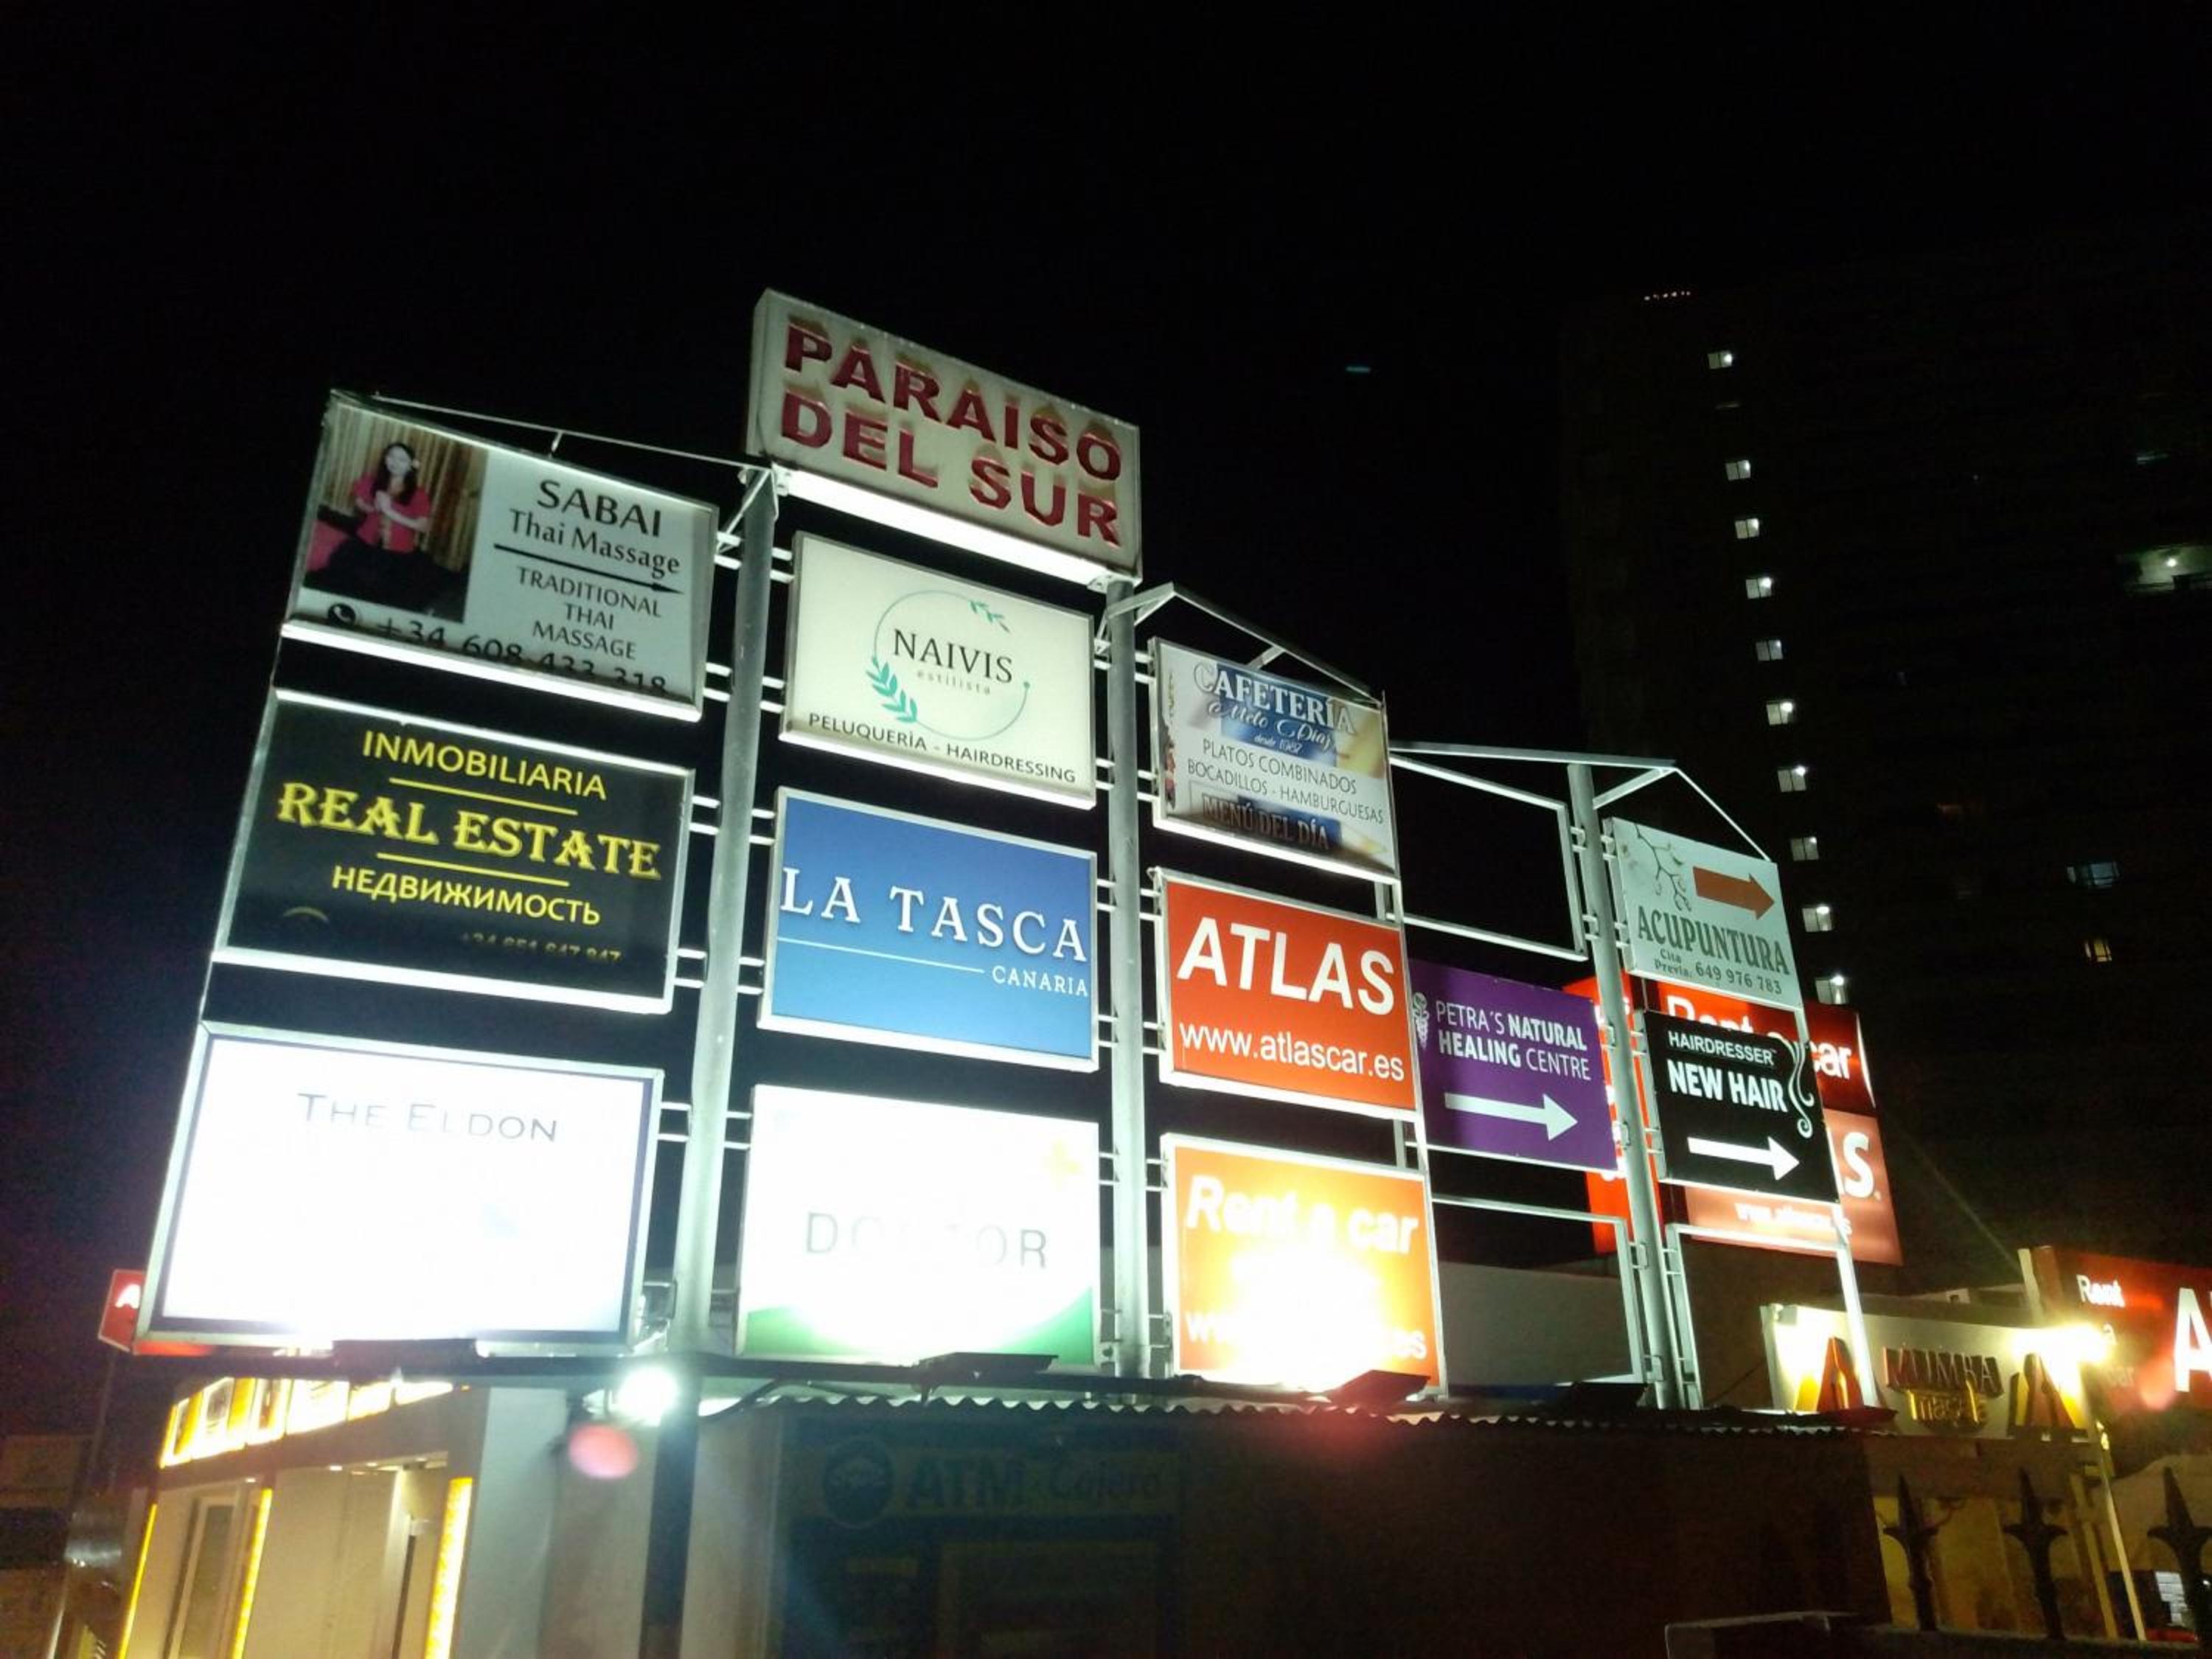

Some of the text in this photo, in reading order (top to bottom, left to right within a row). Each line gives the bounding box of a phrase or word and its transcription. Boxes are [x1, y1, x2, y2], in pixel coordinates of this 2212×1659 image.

[785, 323, 1121, 481] PARAISO
[781, 391, 1121, 549] DEL SUR
[536, 479, 661, 537] SABAI
[509, 508, 681, 578] Thai Massage
[517, 567, 661, 618] TRADITIONAL
[565, 602, 614, 630] THAI
[532, 621, 637, 660] MASSAGE
[894, 629, 1013, 684] NAIVIS
[917, 669, 992, 695] estilista
[362, 731, 607, 800] INMOBILIARIA
[947, 742, 1076, 783] HAIRDRESSING
[1202, 737, 1357, 796] PLATOS COMBINADOS
[1187, 758, 1267, 796] BOCADILLOS
[1280, 785, 1385, 825] HAMBURGUESAS
[277, 782, 661, 881] REAL ESTATE
[1259, 810, 1290, 839] DEL
[332, 866, 601, 926] НЕДВИЖИМОСТЬ
[780, 867, 1087, 963] LA TASCA
[1177, 917, 1395, 1015] ATLAS
[1638, 905, 1790, 975] ACUPUNTURA
[992, 965, 1088, 998] CANARIA
[1696, 961, 1722, 981] 649
[1725, 969, 1753, 988] 976
[1179, 1022, 1405, 1082] www.atlascar.es
[1439, 1029, 1591, 1081] HEALING CENTRE
[1508, 1013, 1587, 1051] NATURAL
[1667, 1031, 1774, 1066] HAIRDRESSER
[1667, 1059, 1789, 1113] NEW HAIR
[1349, 1207, 1419, 1255] car
